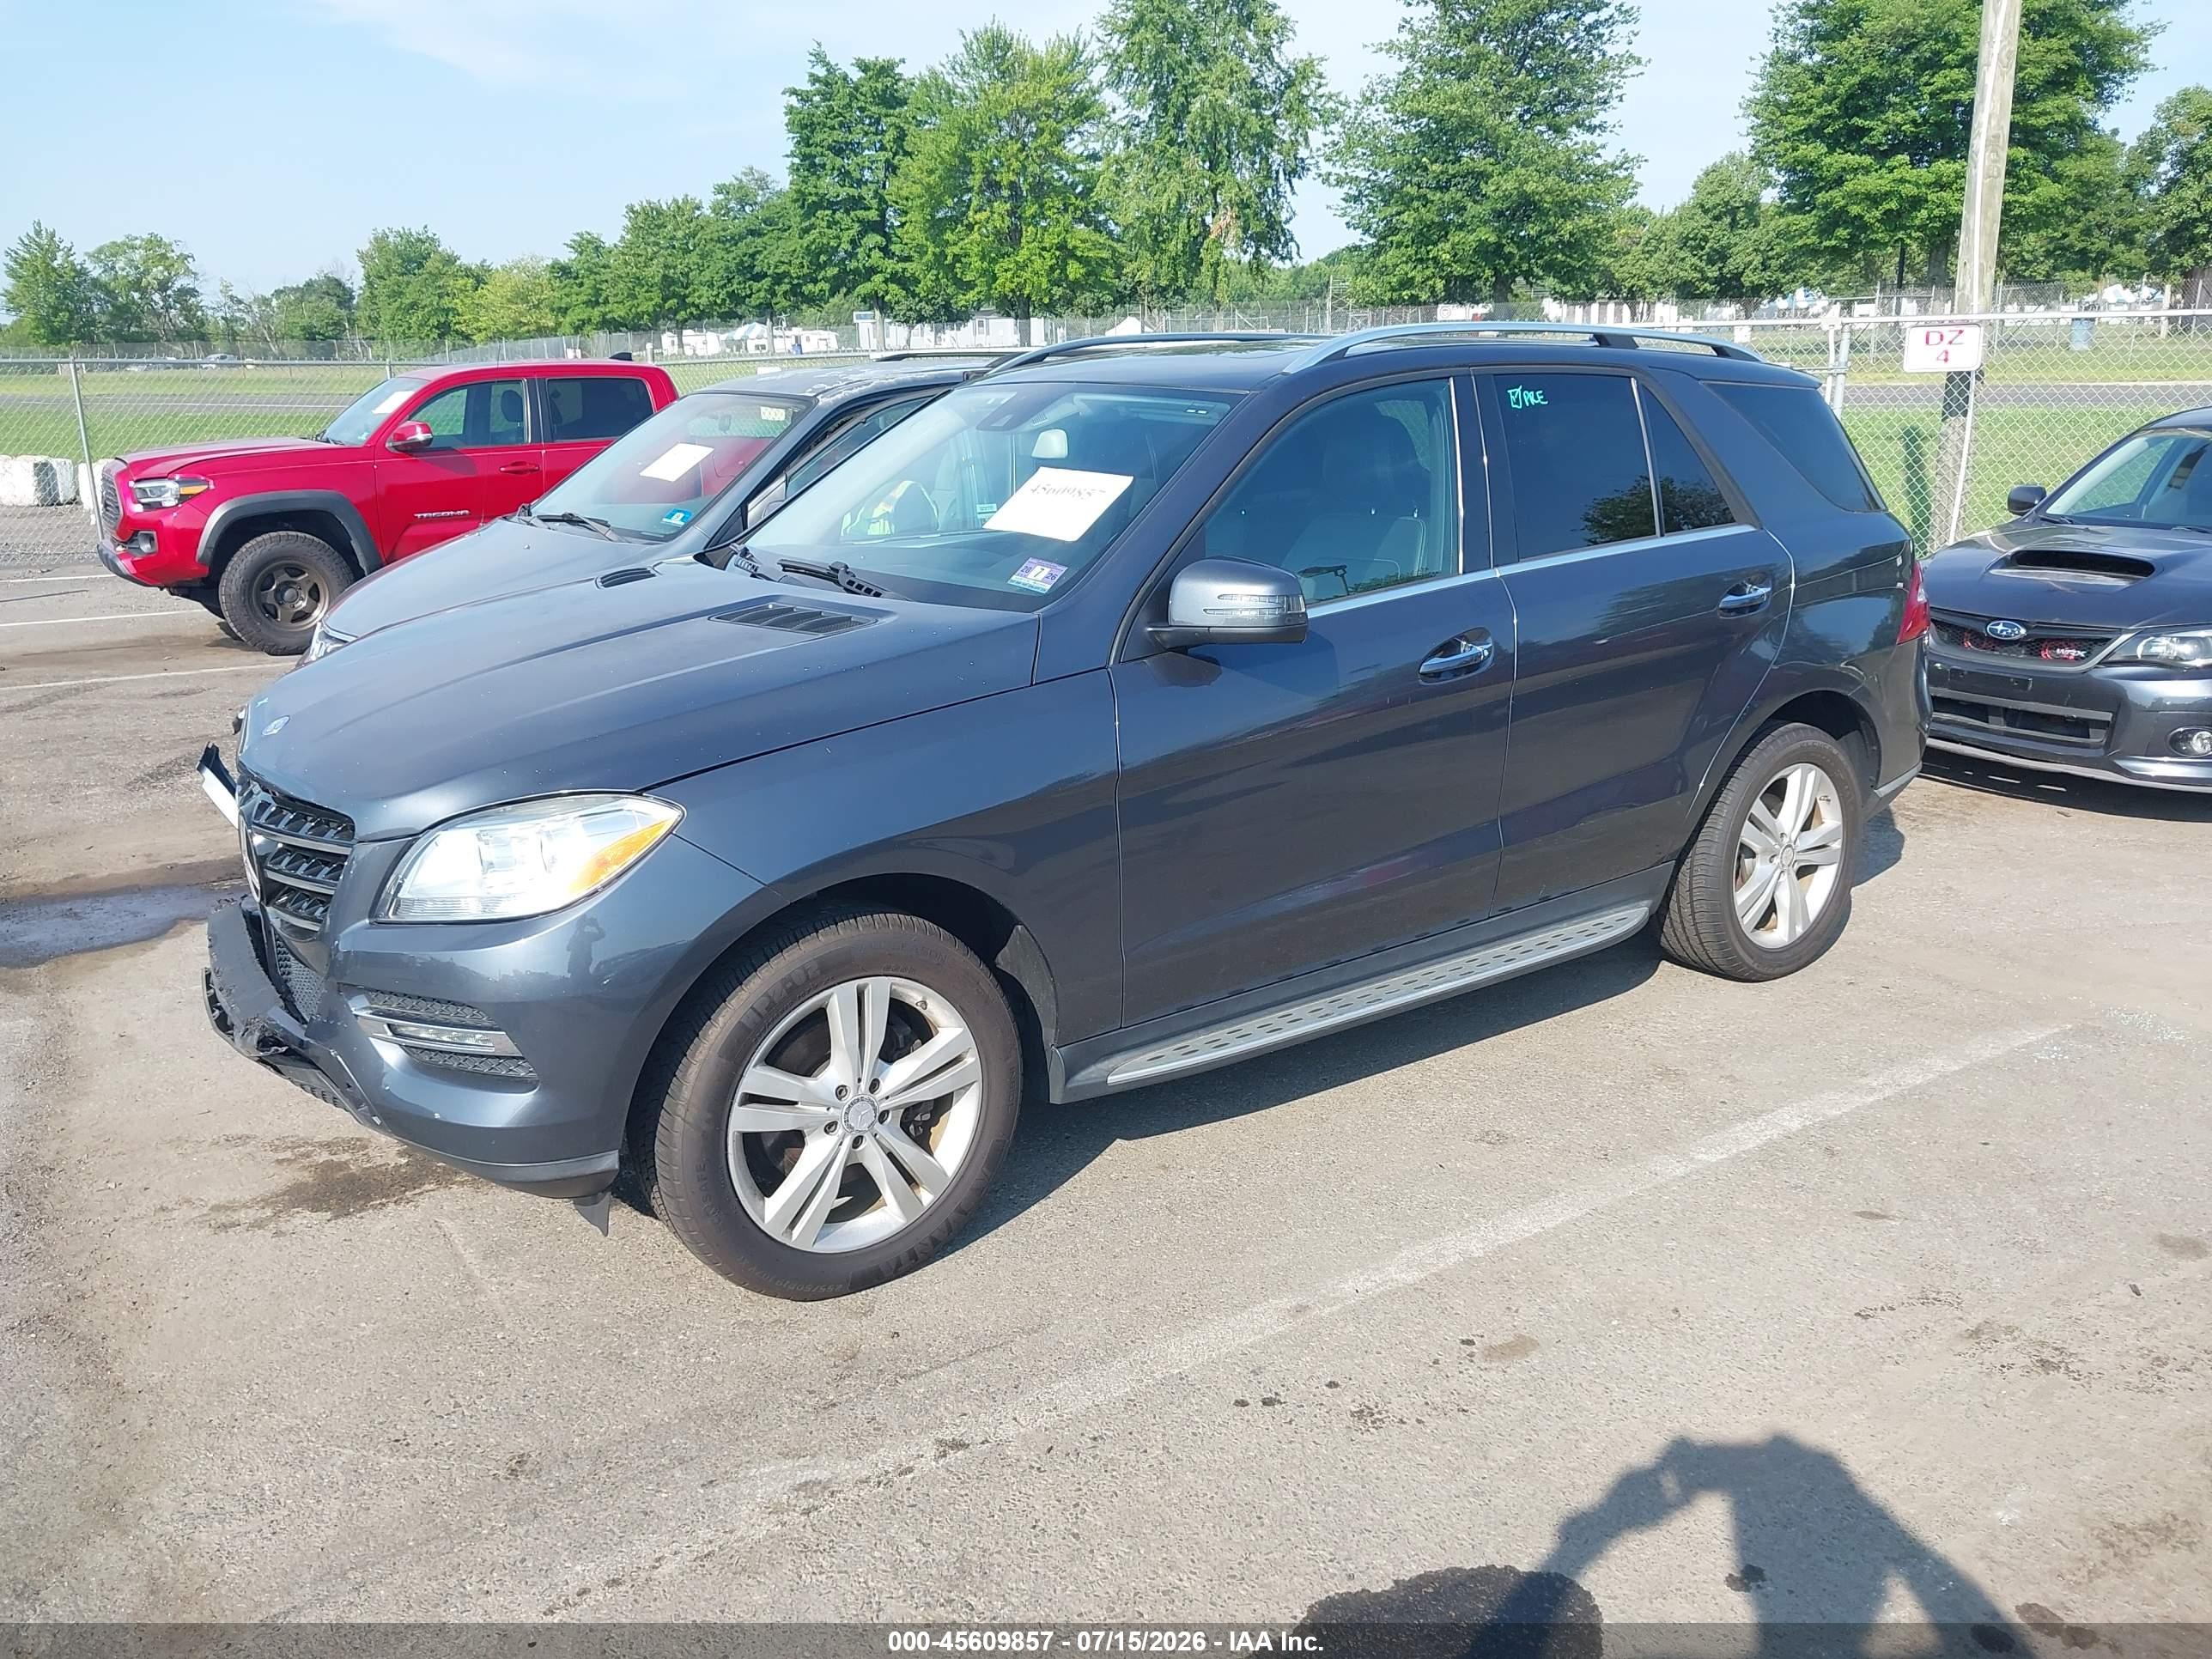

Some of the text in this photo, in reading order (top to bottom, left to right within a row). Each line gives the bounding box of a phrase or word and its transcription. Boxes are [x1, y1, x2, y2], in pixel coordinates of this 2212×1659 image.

[1925, 329, 1965, 346] DZ
[1936, 349, 1949, 363] 4
[1522, 390, 1549, 407] PRE
[413, 509, 470, 520] TACOMA
[1020, 565, 1032, 574] 20
[1034, 568, 1045, 578] 7
[1045, 572, 1059, 580] 26
[2056, 647, 2087, 658] WRX
